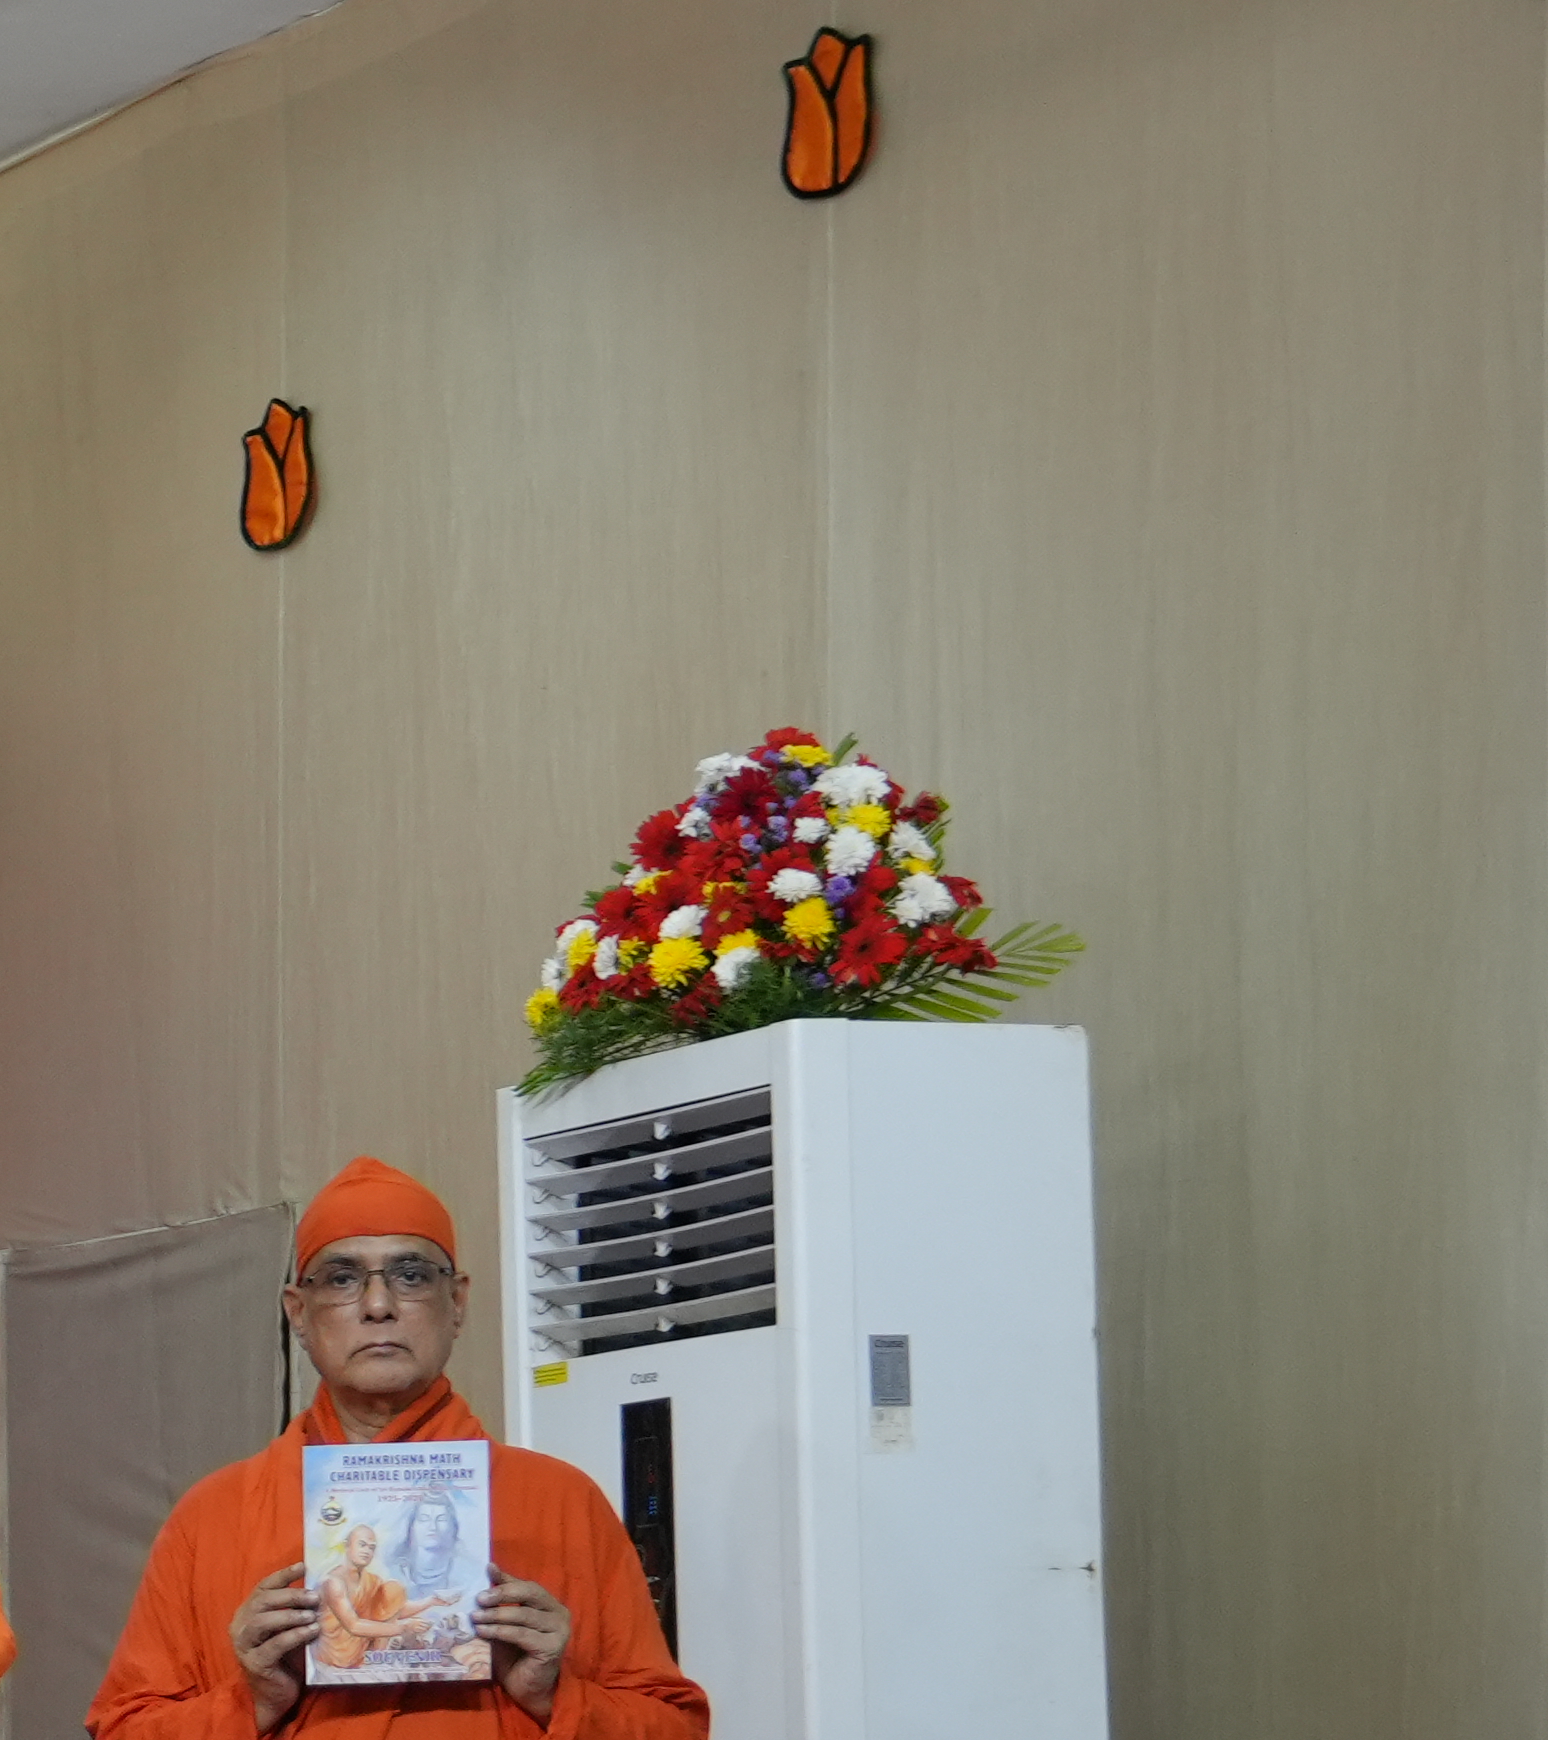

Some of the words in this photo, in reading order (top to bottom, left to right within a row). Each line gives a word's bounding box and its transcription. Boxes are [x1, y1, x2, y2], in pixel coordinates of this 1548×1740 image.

[342, 1454, 425, 1466] RAMAKRISHNA
[429, 1453, 462, 1464] MATH
[329, 1469, 400, 1482] CHARITABLE
[403, 1468, 475, 1481] DISPENSARY
